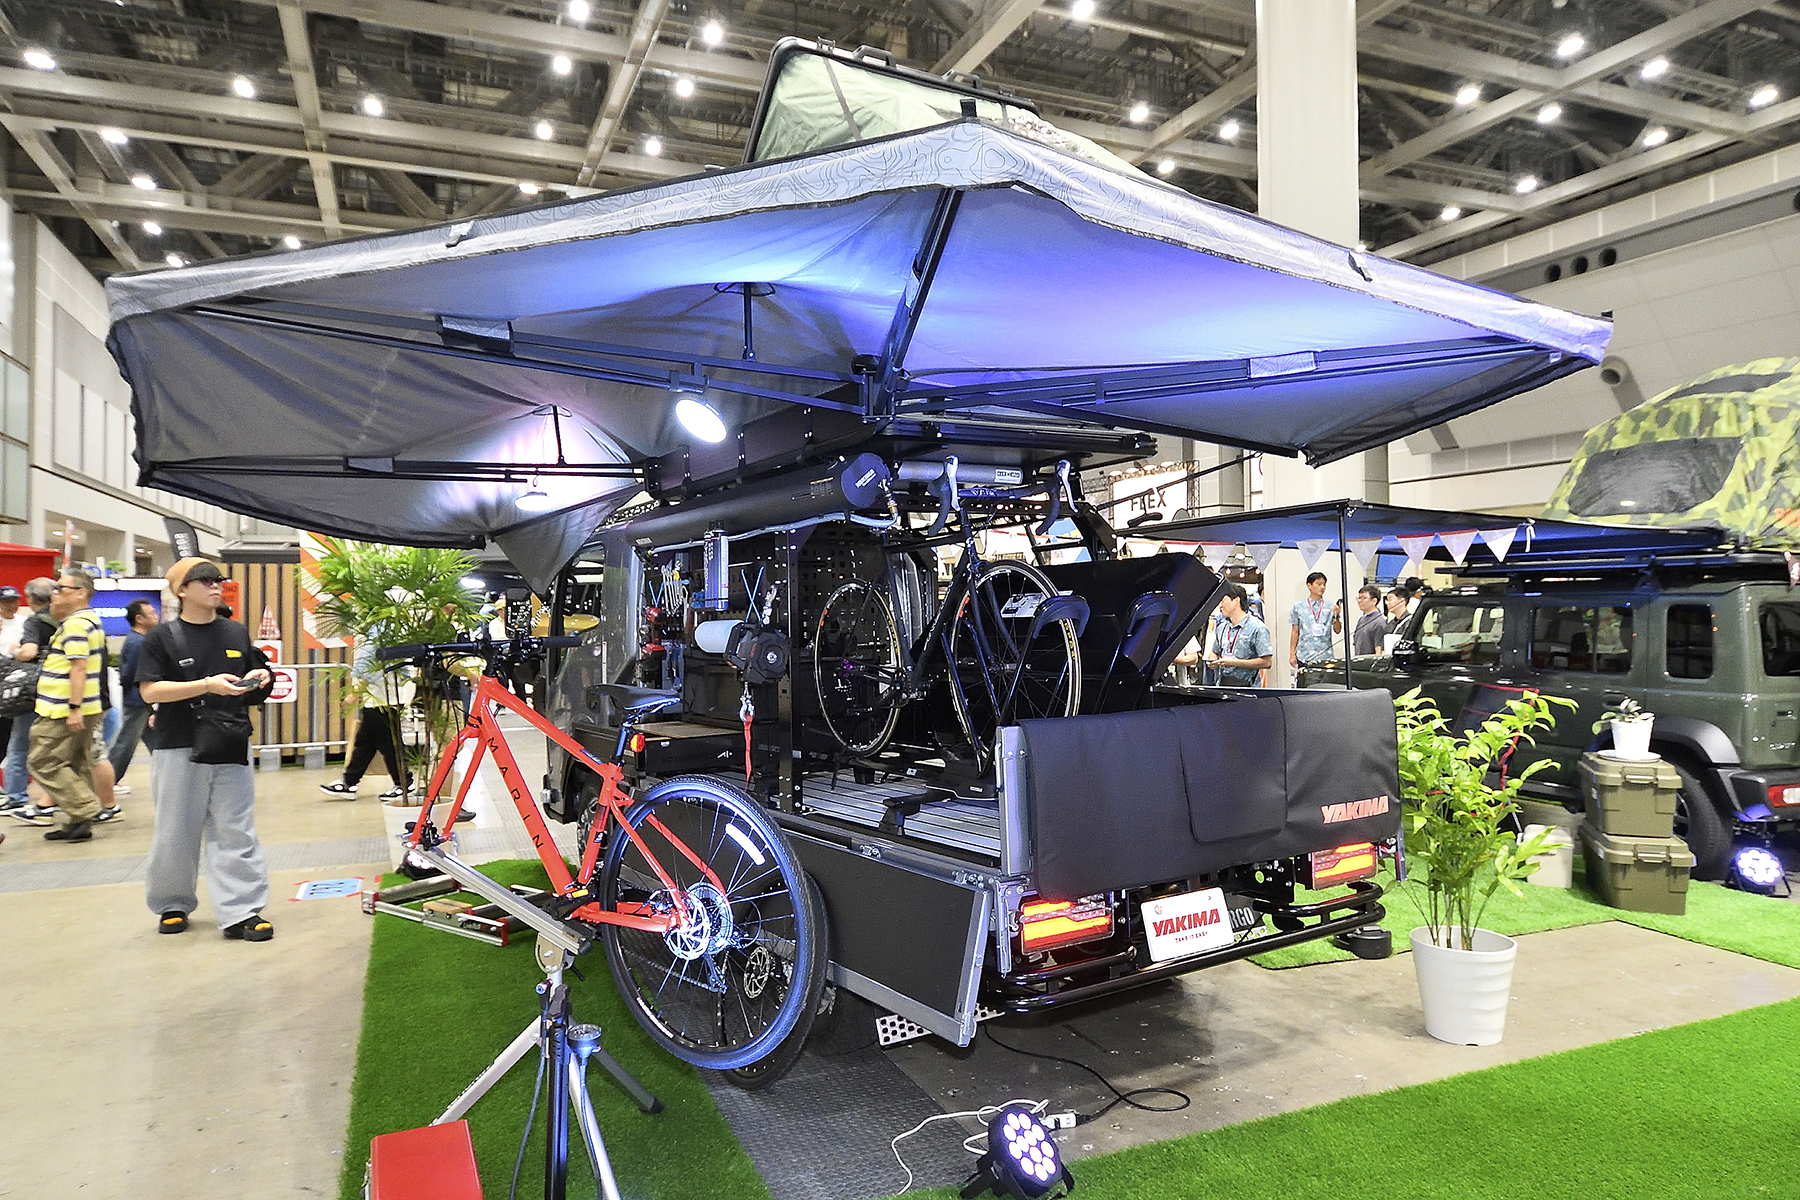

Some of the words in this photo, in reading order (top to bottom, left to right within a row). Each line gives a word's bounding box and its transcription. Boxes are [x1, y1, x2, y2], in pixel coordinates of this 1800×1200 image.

[1130, 489, 1167, 511] FLEX
[487, 737, 544, 848] MARIN
[1321, 795, 1389, 824] YAKIMA
[1152, 908, 1221, 938] YAKIMA
[1228, 906, 1255, 929] RGO
